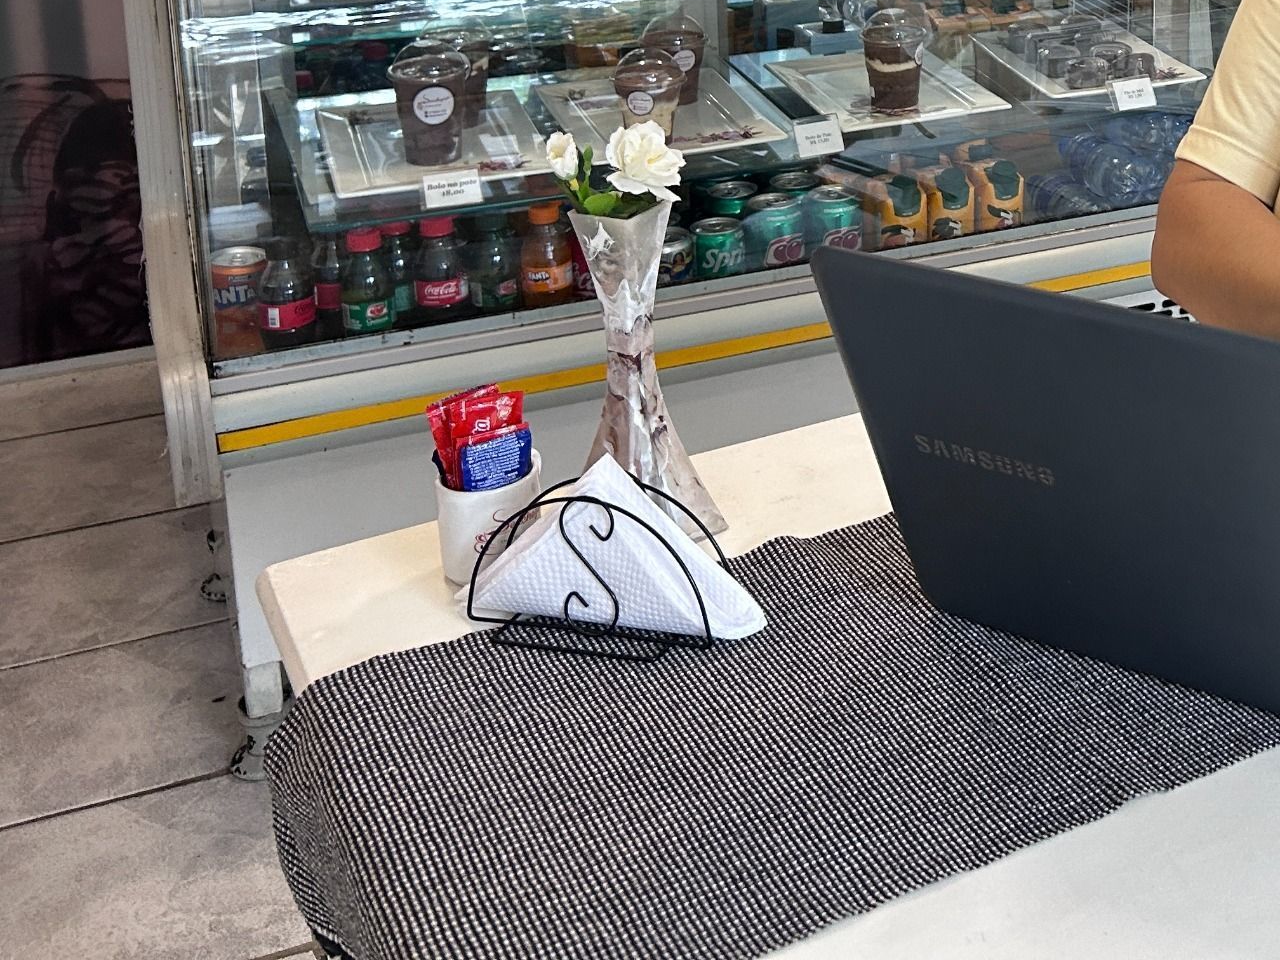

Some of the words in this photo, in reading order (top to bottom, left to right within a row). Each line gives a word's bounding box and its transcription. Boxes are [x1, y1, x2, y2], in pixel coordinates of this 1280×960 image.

[427, 183, 446, 191] Bolo
[527, 271, 550, 283] FANTA
[424, 281, 459, 295] Coca-Cola
[913, 433, 1056, 486] SAMSUNG
